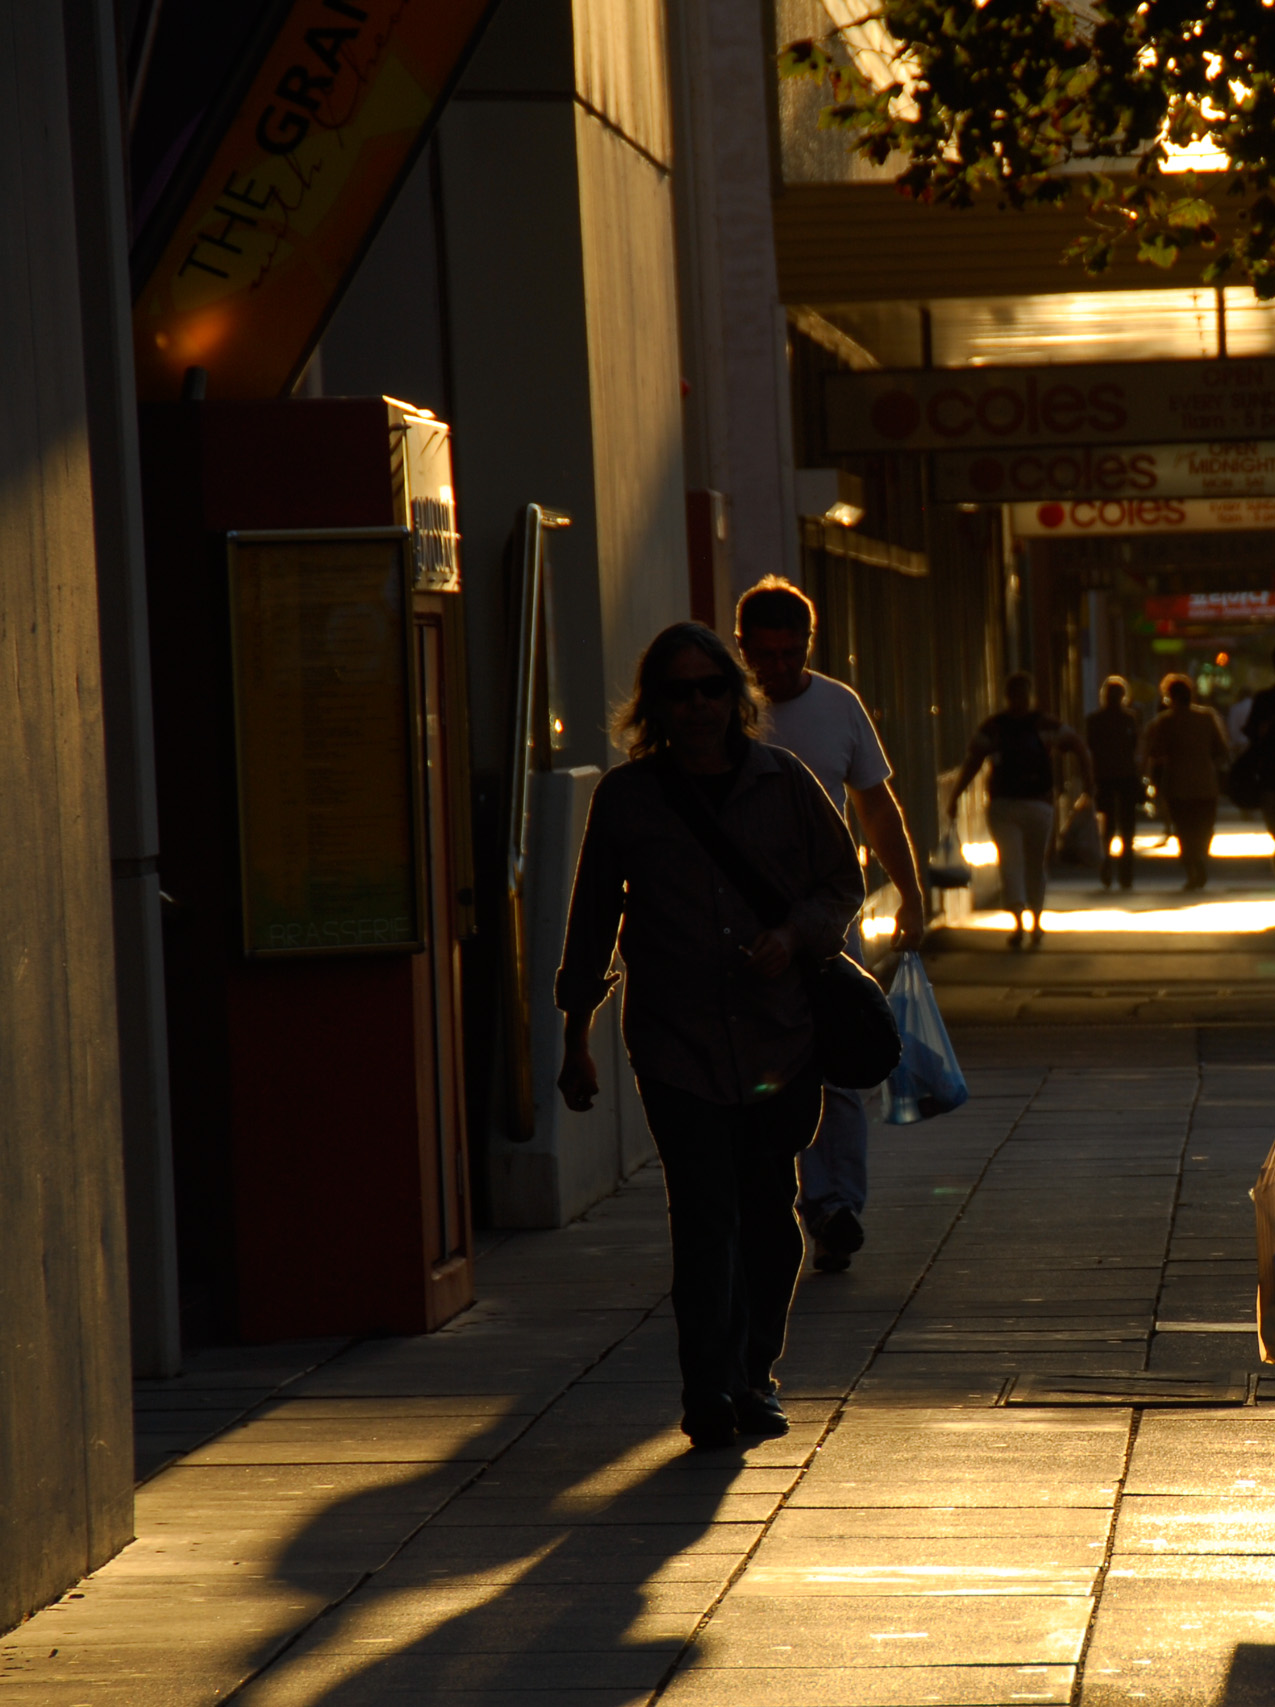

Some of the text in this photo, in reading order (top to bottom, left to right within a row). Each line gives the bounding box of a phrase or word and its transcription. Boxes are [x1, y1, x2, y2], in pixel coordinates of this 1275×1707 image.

[177, 171, 275, 279] THE
[1202, 366, 1264, 387] OPEN
[927, 376, 1127, 437] coles
[1168, 394, 1224, 412] EVERY
[1209, 441, 1258, 456] OPEN
[1009, 447, 1157, 493] coles
[1070, 499, 1186, 529] coles
[269, 915, 409, 949] BRASSERIE
